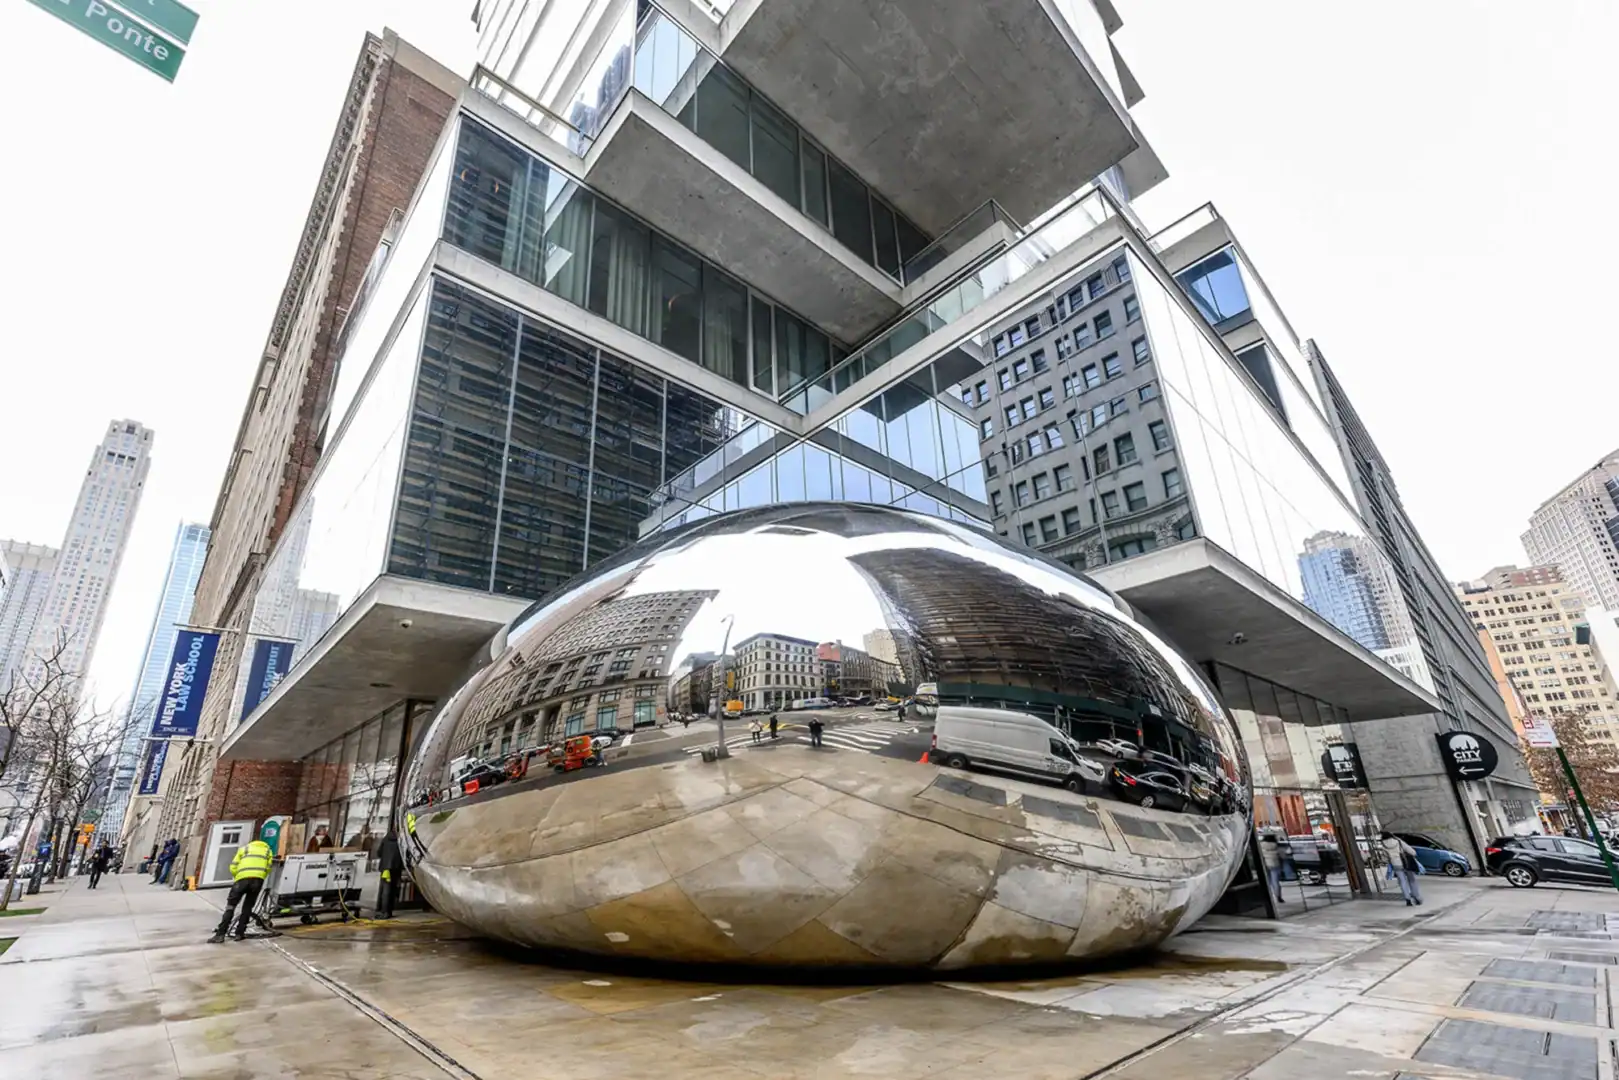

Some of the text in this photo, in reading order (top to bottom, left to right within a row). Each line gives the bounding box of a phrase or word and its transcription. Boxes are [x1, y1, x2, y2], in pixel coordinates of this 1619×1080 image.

[85, 1, 169, 60] Ponte
[160, 662, 187, 725] NEW YORK
[175, 635, 205, 712] LAW SCHOOL
[1453, 750, 1480, 759] CITY
